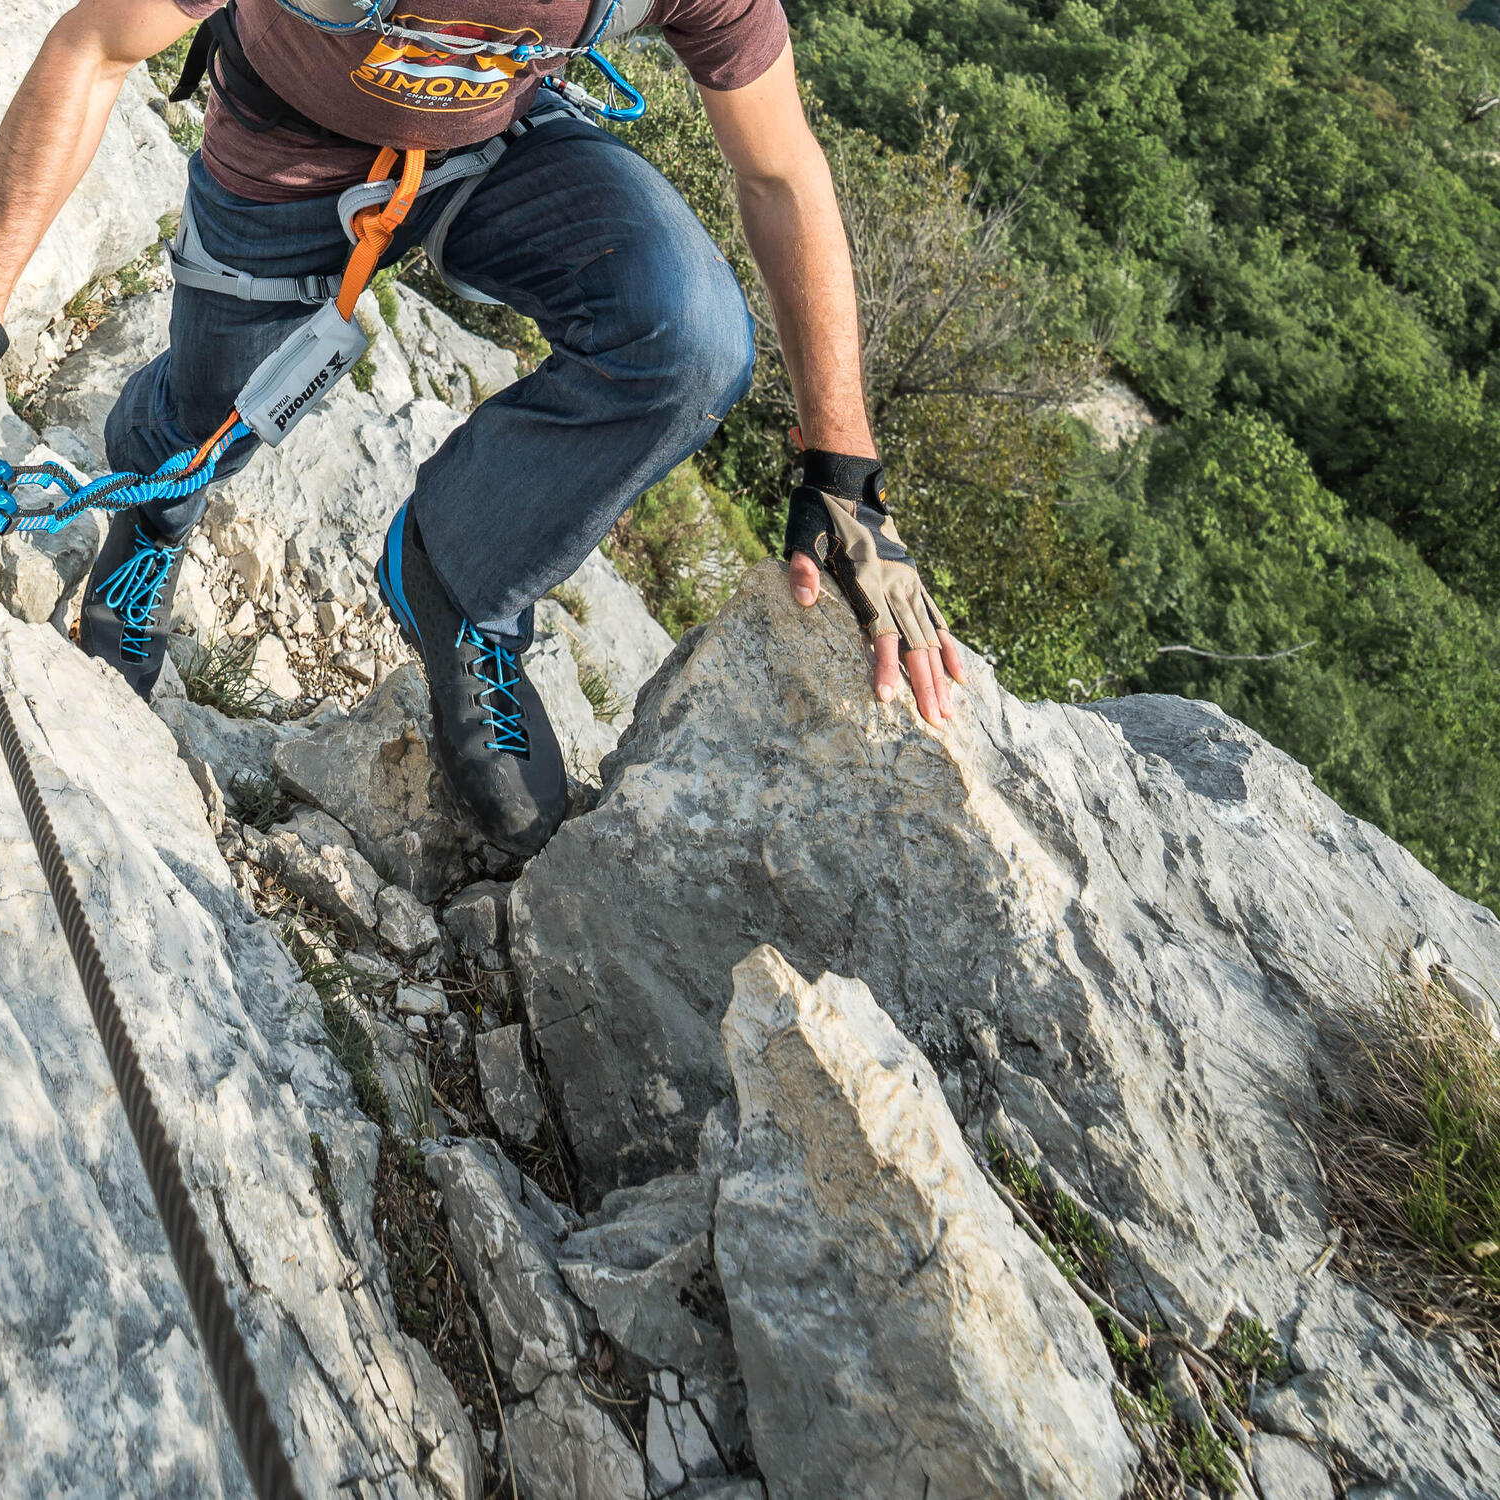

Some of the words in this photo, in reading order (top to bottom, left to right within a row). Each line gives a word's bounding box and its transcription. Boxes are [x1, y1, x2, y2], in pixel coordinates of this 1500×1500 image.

[356, 65, 509, 98] SIMOND
[406, 92, 453, 102] CHAMONIX
[268, 395, 291, 419] VITALINK
[274, 369, 329, 432] simond
